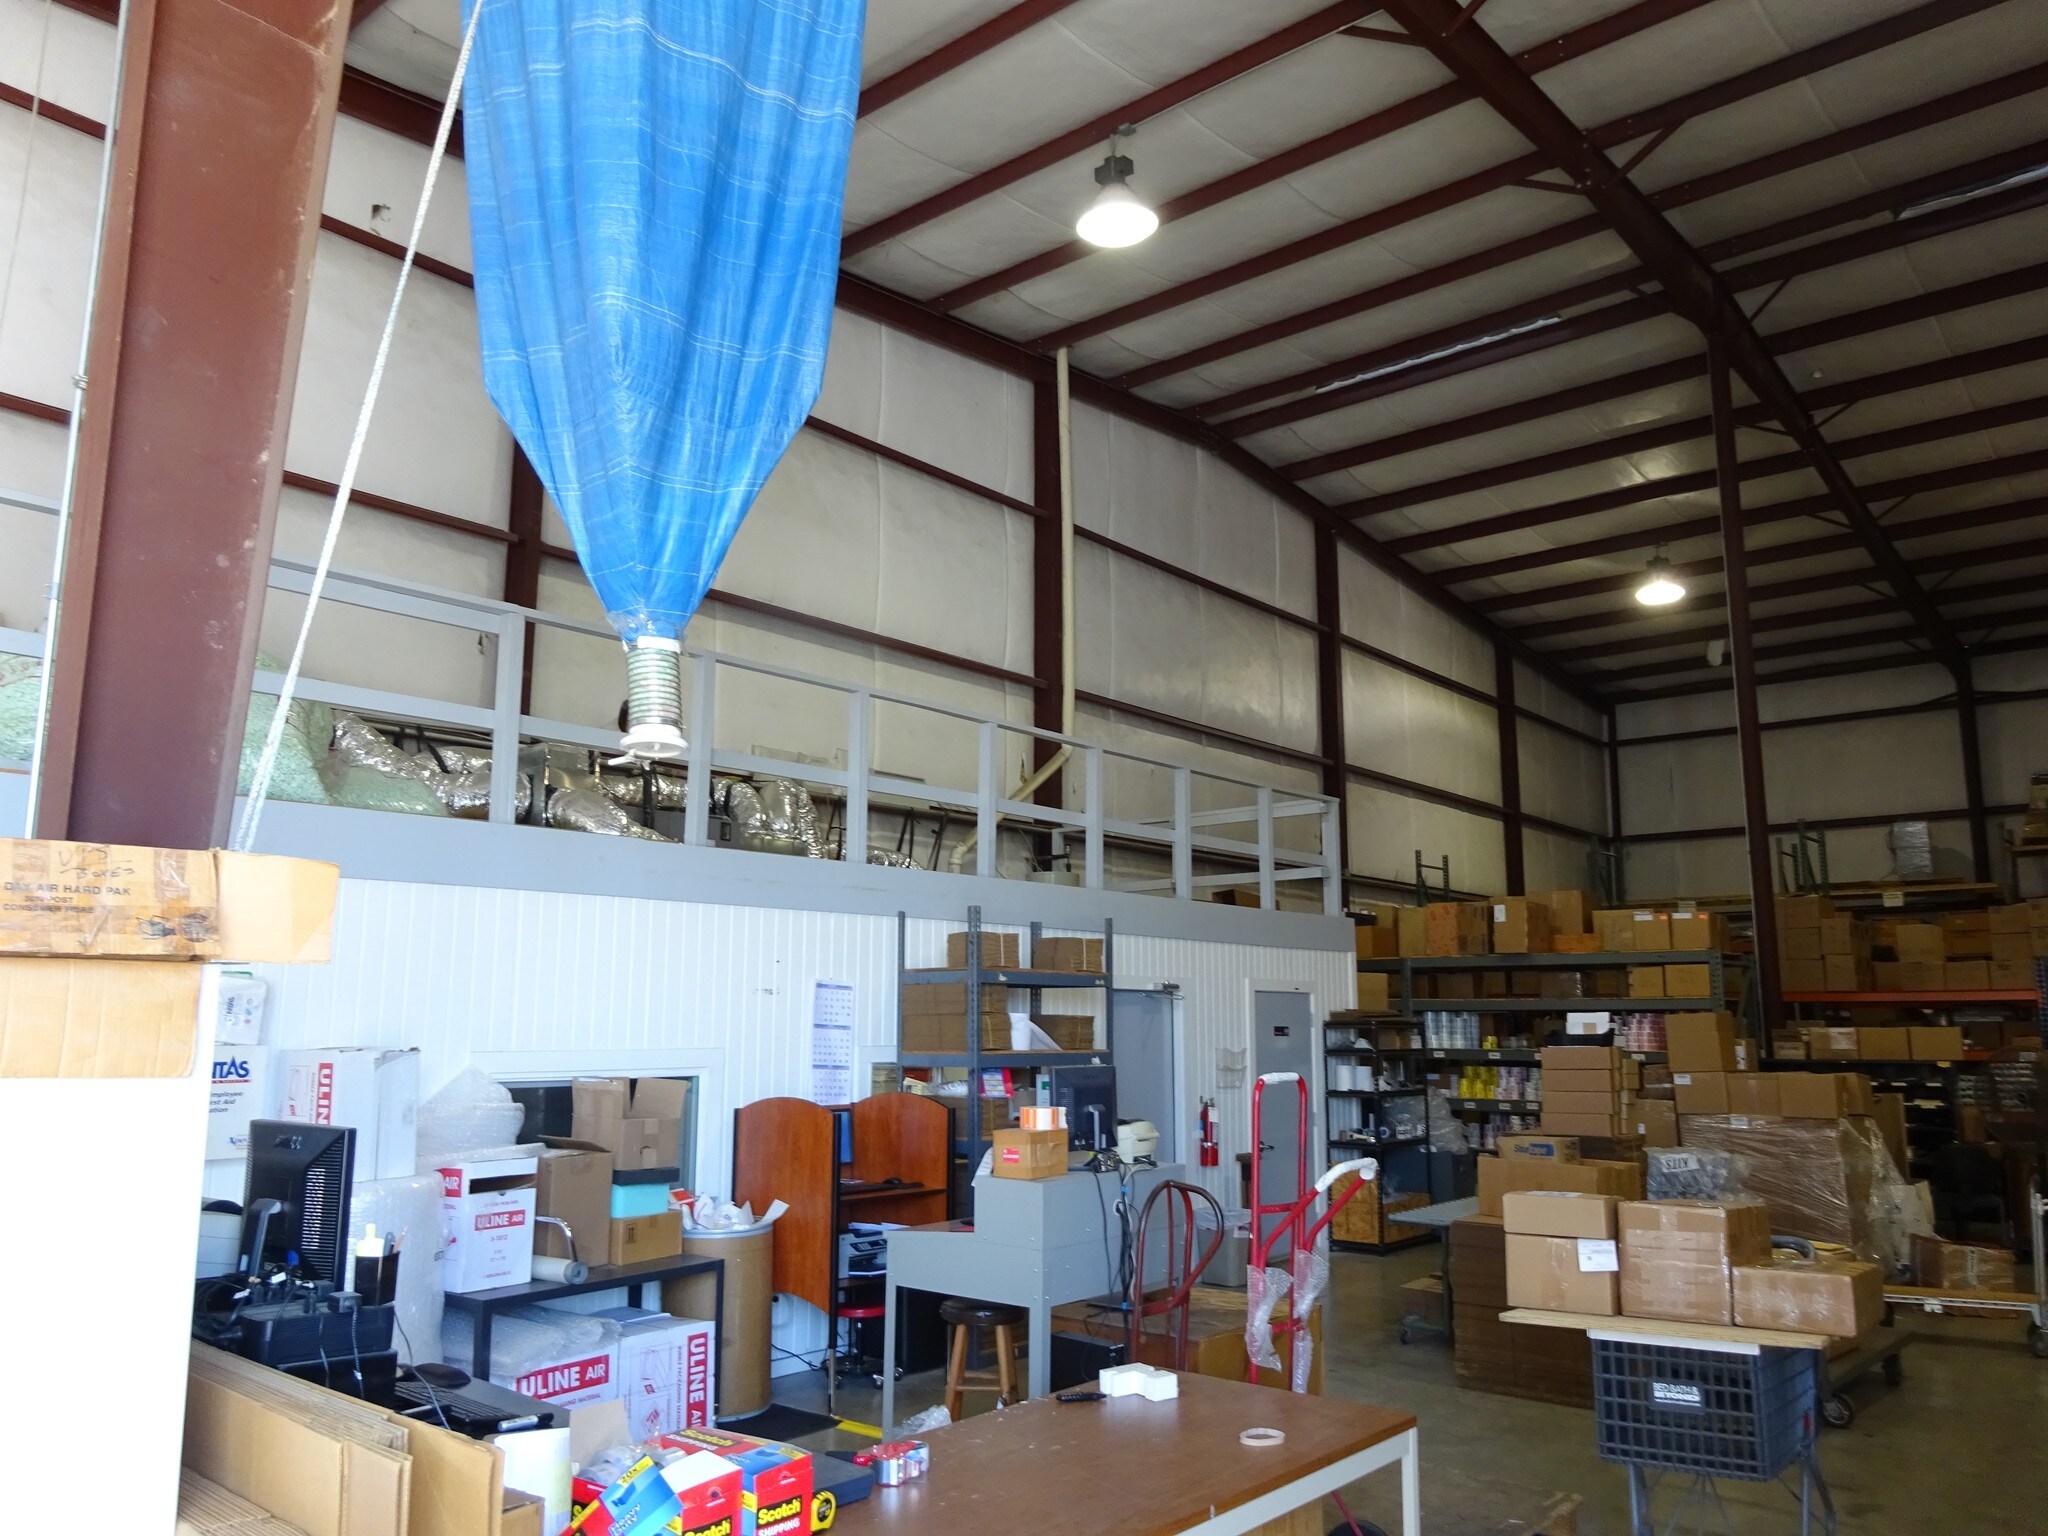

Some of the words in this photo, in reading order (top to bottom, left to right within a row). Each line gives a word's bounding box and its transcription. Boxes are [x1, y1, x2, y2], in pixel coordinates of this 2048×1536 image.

[36, 883, 59, 893] AIR
[63, 884, 101, 895] HARD
[106, 886, 131, 896] PAK
[317, 1068, 331, 1125] ULIN
[444, 1176, 460, 1190] AIR
[476, 1213, 510, 1229] ULINE
[511, 1213, 525, 1223] AIR
[689, 1337, 706, 1404] ULINE
[521, 1365, 580, 1397] ULINE
[585, 1363, 606, 1381] AIR
[1653, 1382, 1669, 1392] BED
[1669, 1383, 1691, 1394] BATH
[1653, 1391, 1701, 1402] BEYOND
[691, 1410, 703, 1427] AI
[665, 1433, 719, 1451] SHIPPING
[680, 1429, 734, 1447] Scotch
[757, 1498, 802, 1525] Scotch
[757, 1517, 801, 1536] SHIPPING
